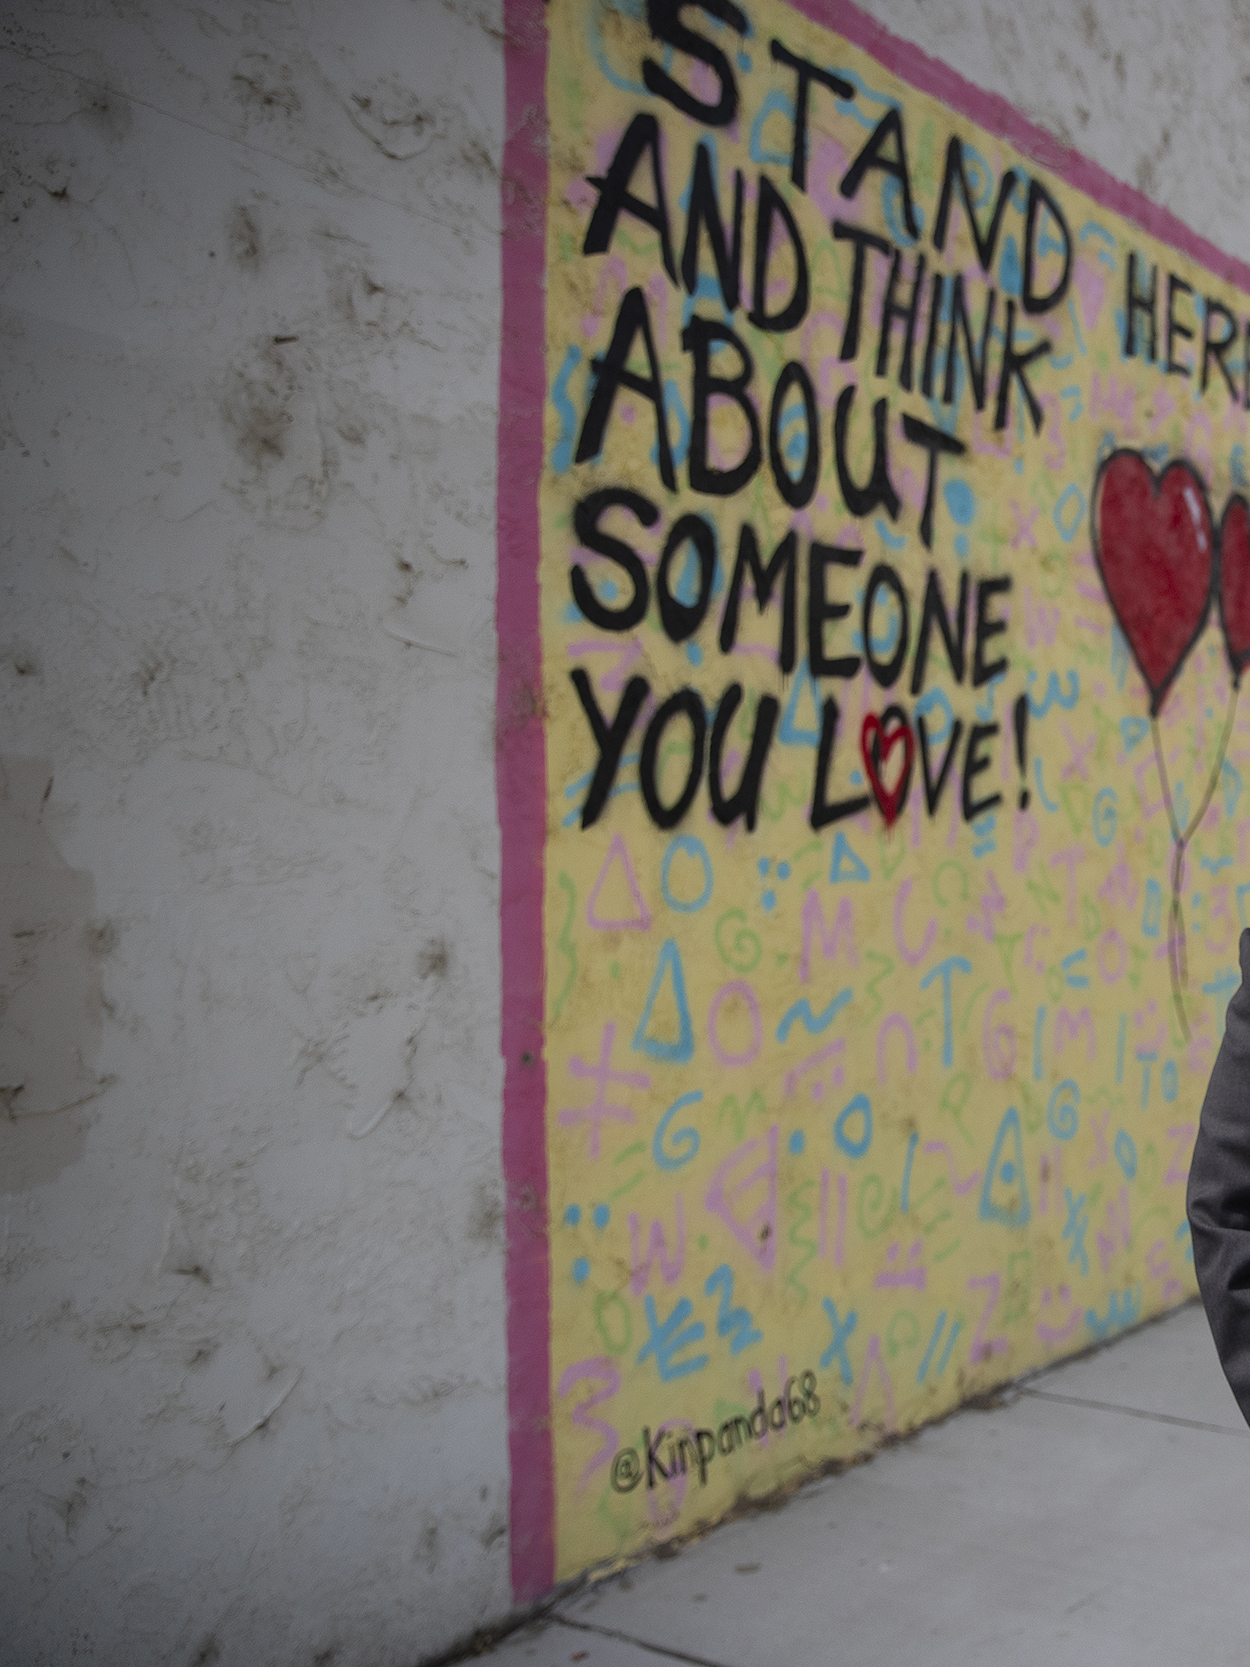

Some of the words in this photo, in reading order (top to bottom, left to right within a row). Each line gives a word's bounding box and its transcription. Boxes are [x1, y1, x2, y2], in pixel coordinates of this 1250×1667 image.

[583, 113, 810, 332] AND
[832, 219, 1052, 435] THINK
[643, 0, 1074, 315] STAND
[574, 287, 966, 549] ABOUT
[570, 487, 1012, 696] SOMEONE
[569, 667, 779, 832] YOU
[810, 693, 1031, 837] LOVE!
